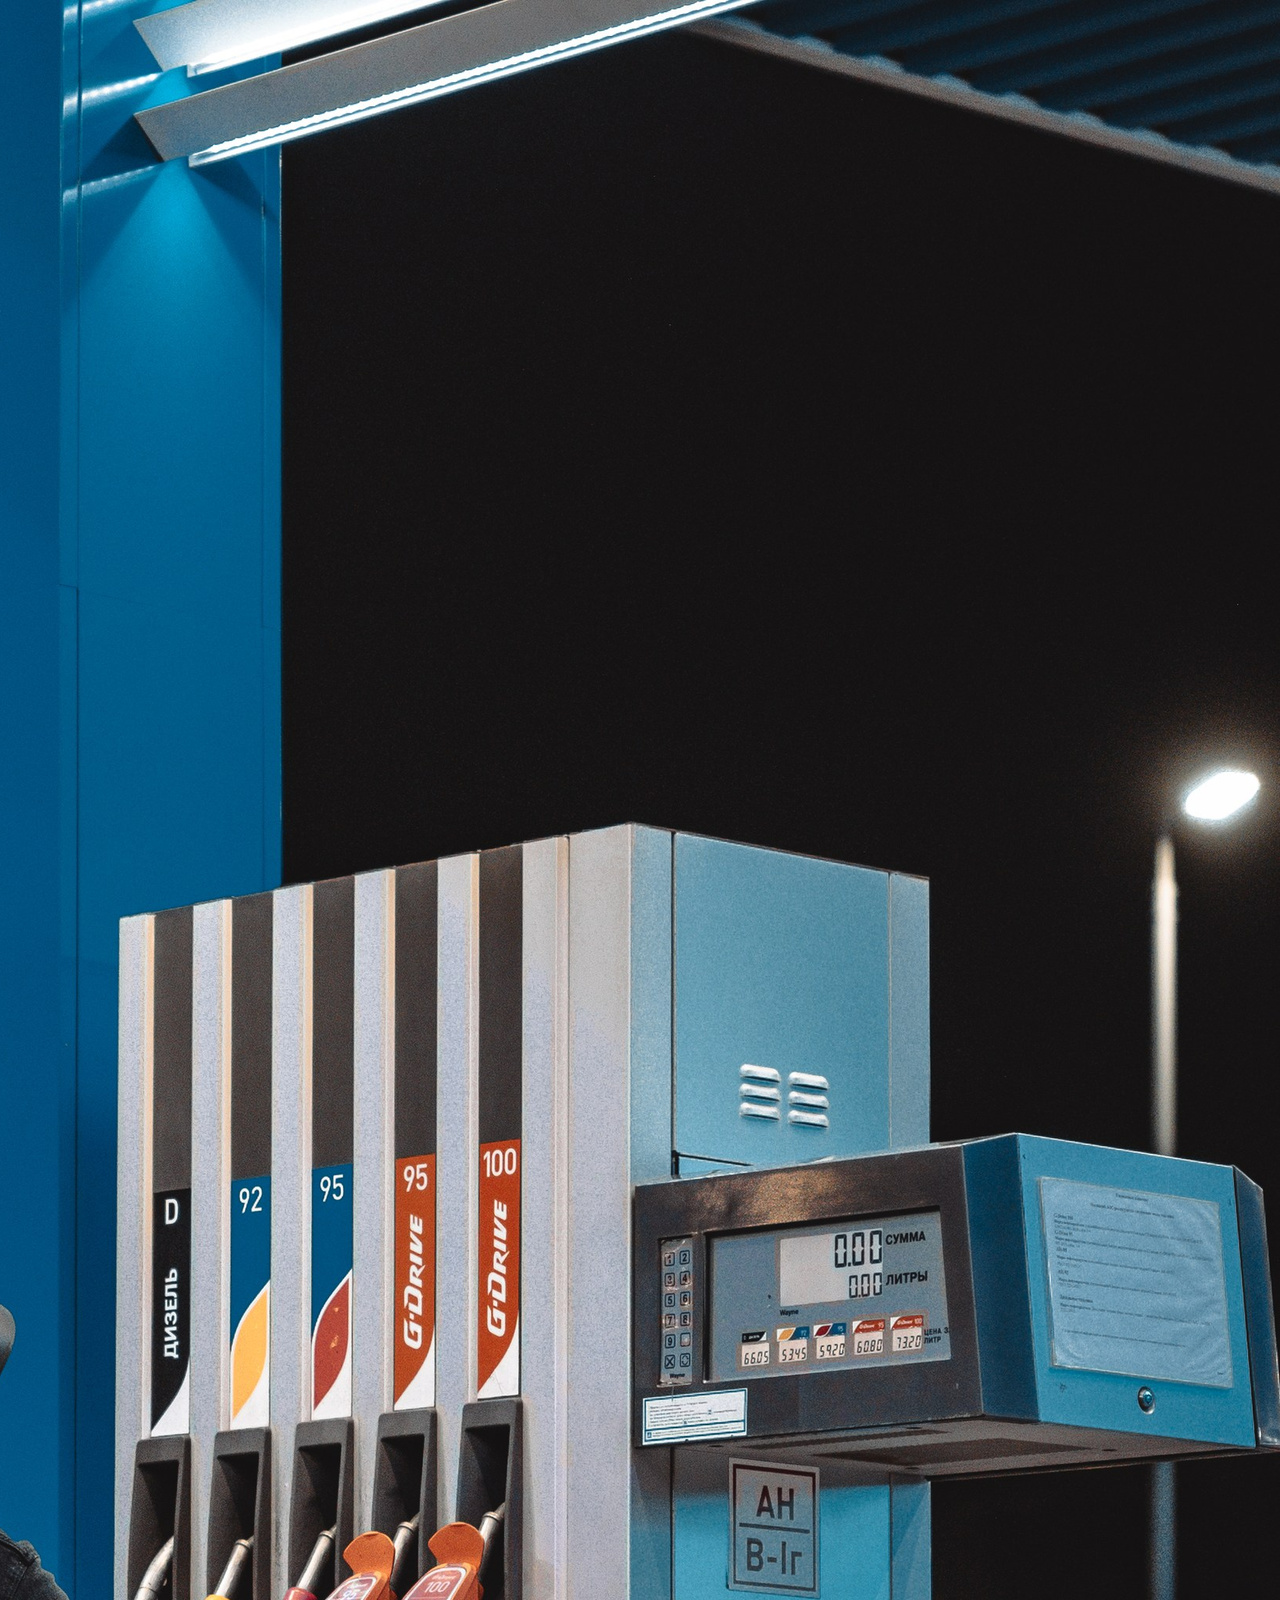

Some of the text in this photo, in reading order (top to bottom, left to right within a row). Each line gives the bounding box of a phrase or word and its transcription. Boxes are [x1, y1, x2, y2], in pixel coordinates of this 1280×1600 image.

[483, 1148, 517, 1178] 100
[320, 1174, 344, 1202] 95
[403, 1163, 428, 1192] 95
[164, 1198, 179, 1225] D
[239, 1186, 263, 1214] 92
[834, 1230, 882, 1268] 0.00
[885, 1231, 926, 1246] СУММА
[849, 1272, 882, 1298] 0.00
[885, 1271, 928, 1286] ЛИТРЫ
[164, 1268, 179, 1358] ДИЗЕЛЬ
[779, 1309, 799, 1317] Wayne
[924, 1327, 942, 1336] ЦЕНА
[756, 1485, 795, 1521] АН
[425, 1581, 450, 1593] 100
